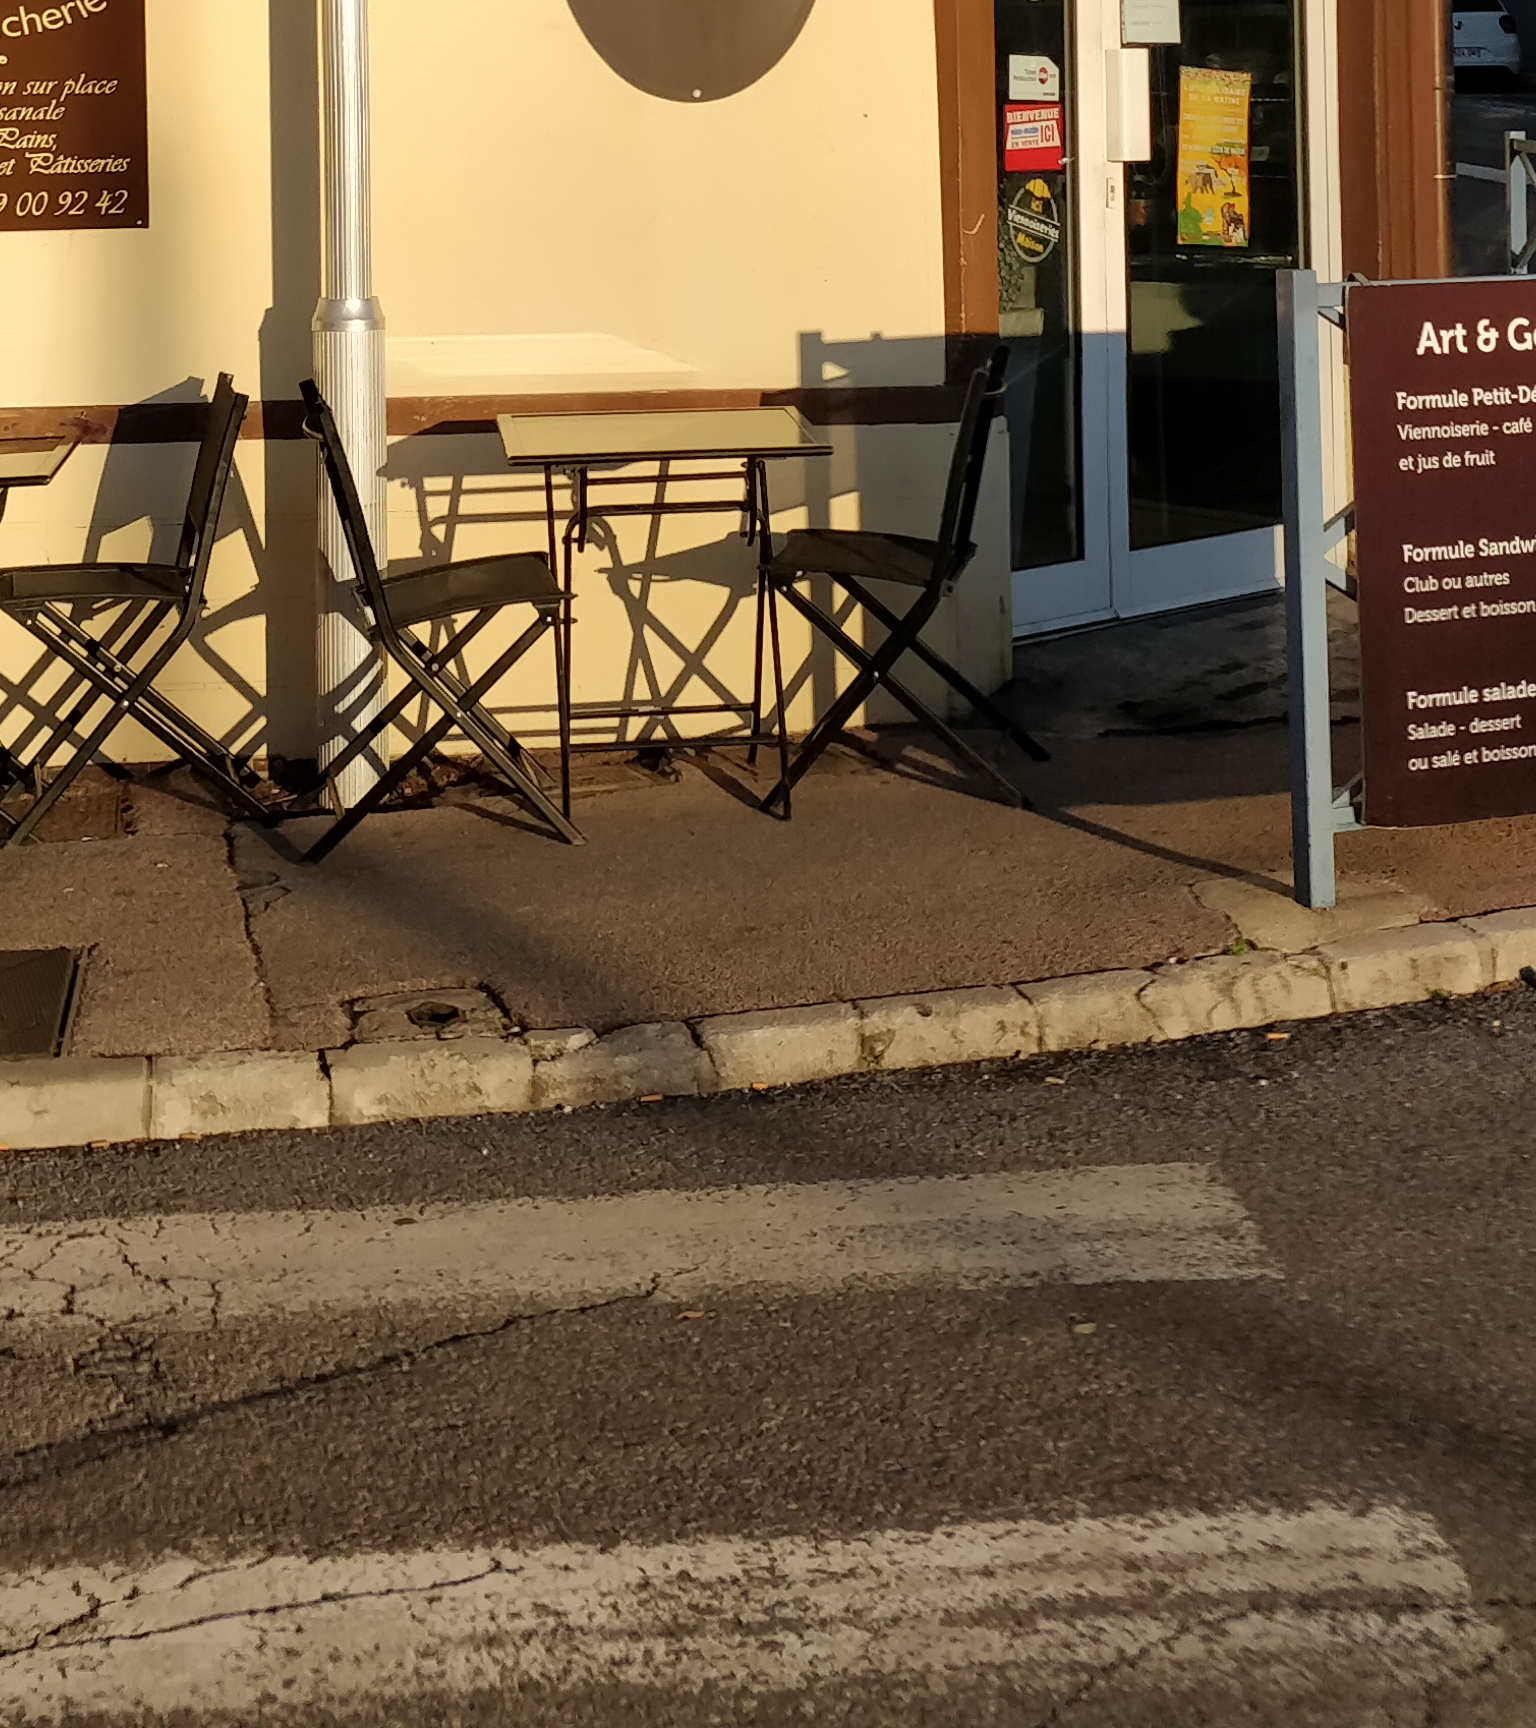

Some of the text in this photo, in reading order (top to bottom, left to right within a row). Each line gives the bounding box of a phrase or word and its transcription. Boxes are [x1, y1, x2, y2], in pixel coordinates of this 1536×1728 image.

[22, 78, 58, 97] sur
[60, 74, 118, 102] place
[1006, 107, 1060, 124] BIENVENUE
[1040, 124, 1054, 143] ICI
[25, 152, 132, 175] Pâtisseries
[16, 191, 49, 216] 00
[53, 190, 89, 216] 92
[95, 189, 129, 215] 42
[1007, 208, 1060, 239] Viennoiseries
[1416, 320, 1468, 355] Art
[1476, 318, 1499, 352] &
[1395, 388, 1469, 410] Formule
[1396, 417, 1533, 440] Viennoiserie café
[1398, 448, 1496, 473] et jus de fruit
[1402, 540, 1475, 563] Formule
[1403, 571, 1510, 593] Club ou autres
[1404, 598, 1536, 624] Dessert et boisson
[1406, 680, 1536, 710] Formule salade
[1407, 714, 1522, 741] Salade dessert
[1407, 756, 1429, 771] ou
[1431, 750, 1460, 769] salé
[1463, 749, 1479, 765] et
